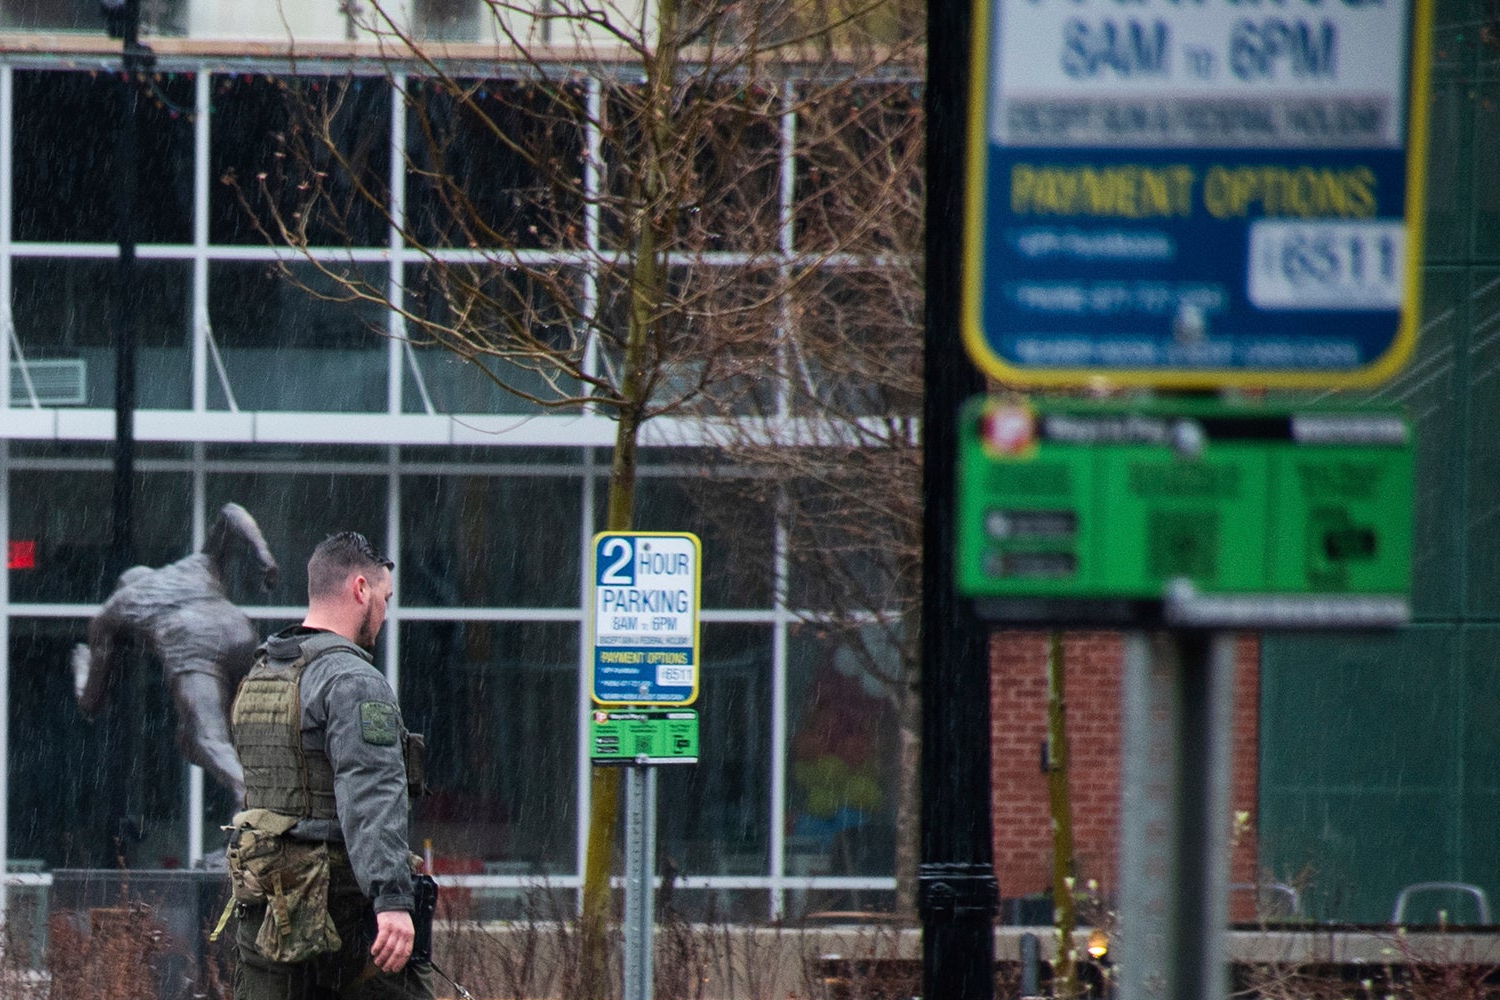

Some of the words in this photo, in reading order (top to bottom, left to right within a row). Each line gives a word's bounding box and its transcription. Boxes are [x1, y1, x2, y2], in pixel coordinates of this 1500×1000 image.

[1229, 17, 1338, 81] 6PM
[1011, 164, 1196, 217] PAYMENT
[1204, 165, 1378, 218] OPTIONS
[601, 537, 634, 585] 2
[640, 552, 690, 575] HOUR
[603, 589, 689, 614] PARKING
[612, 616, 639, 631] 8AM
[652, 616, 678, 631] 6PM
[601, 651, 645, 664] PAYMENT
[647, 652, 688, 665] OPTIONS
